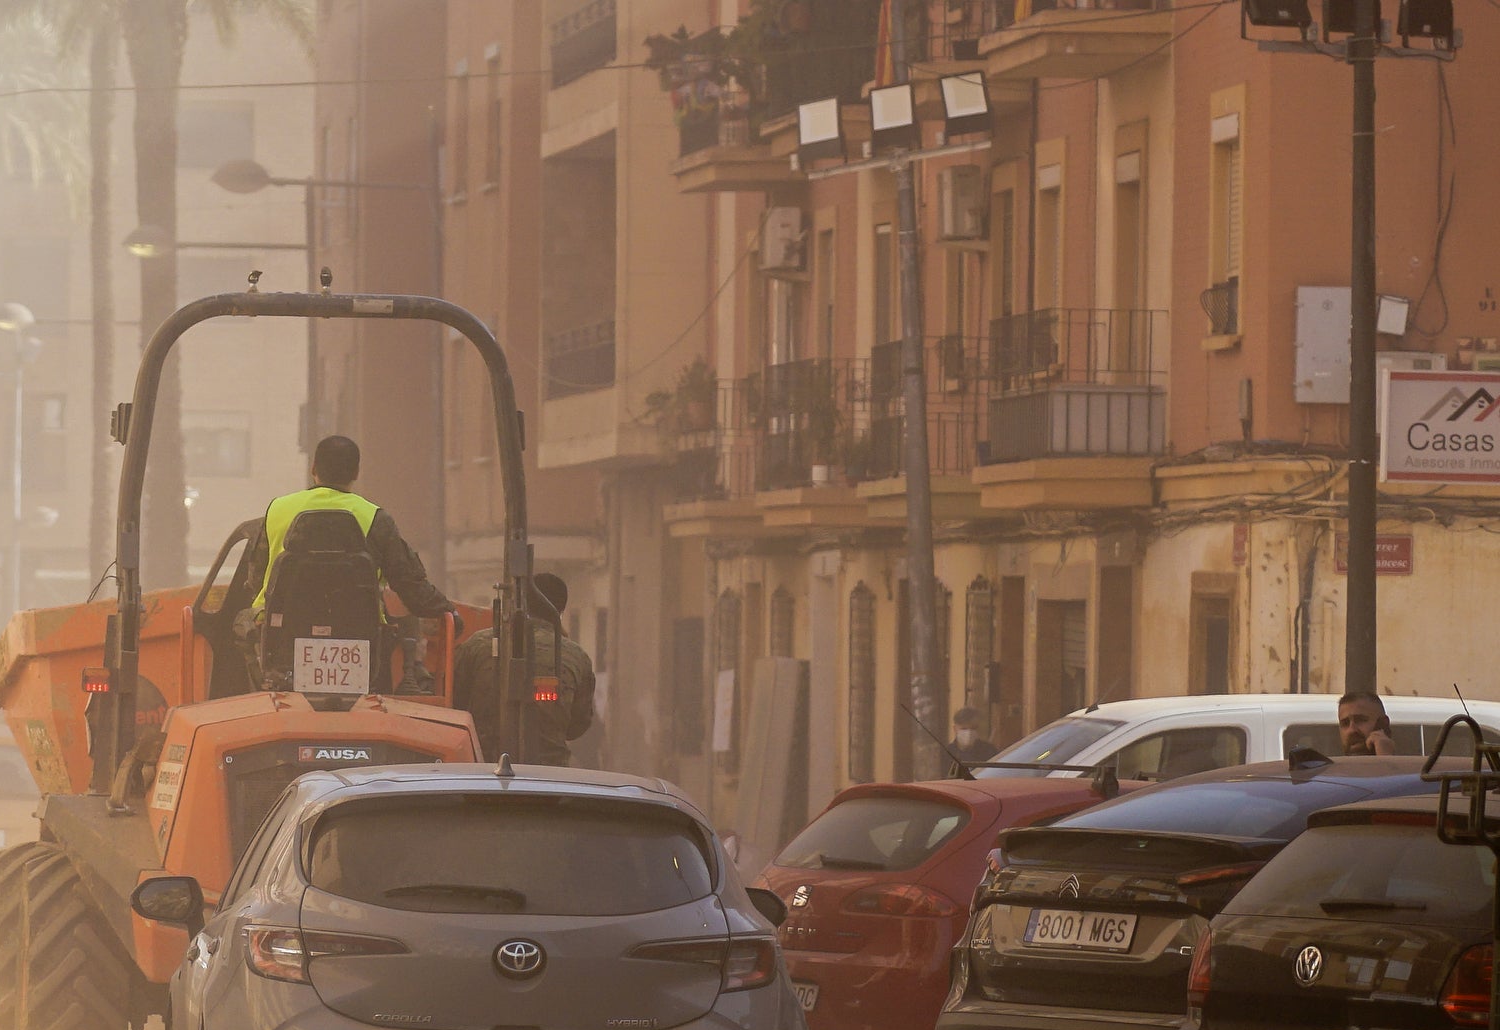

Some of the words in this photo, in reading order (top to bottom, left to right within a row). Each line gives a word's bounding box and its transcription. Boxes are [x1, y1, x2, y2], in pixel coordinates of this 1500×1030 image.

[1407, 422, 1495, 452] Casas
[1404, 455, 1466, 470] Asesores
[303, 646, 314, 663] E
[320, 646, 361, 665] 4786
[313, 668, 351, 686] BHZ
[315, 749, 370, 760] AUSA
[1039, 914, 1085, 939] 8001
[1089, 917, 1128, 944] MGS
[372, 1013, 433, 1024] COROLLA
